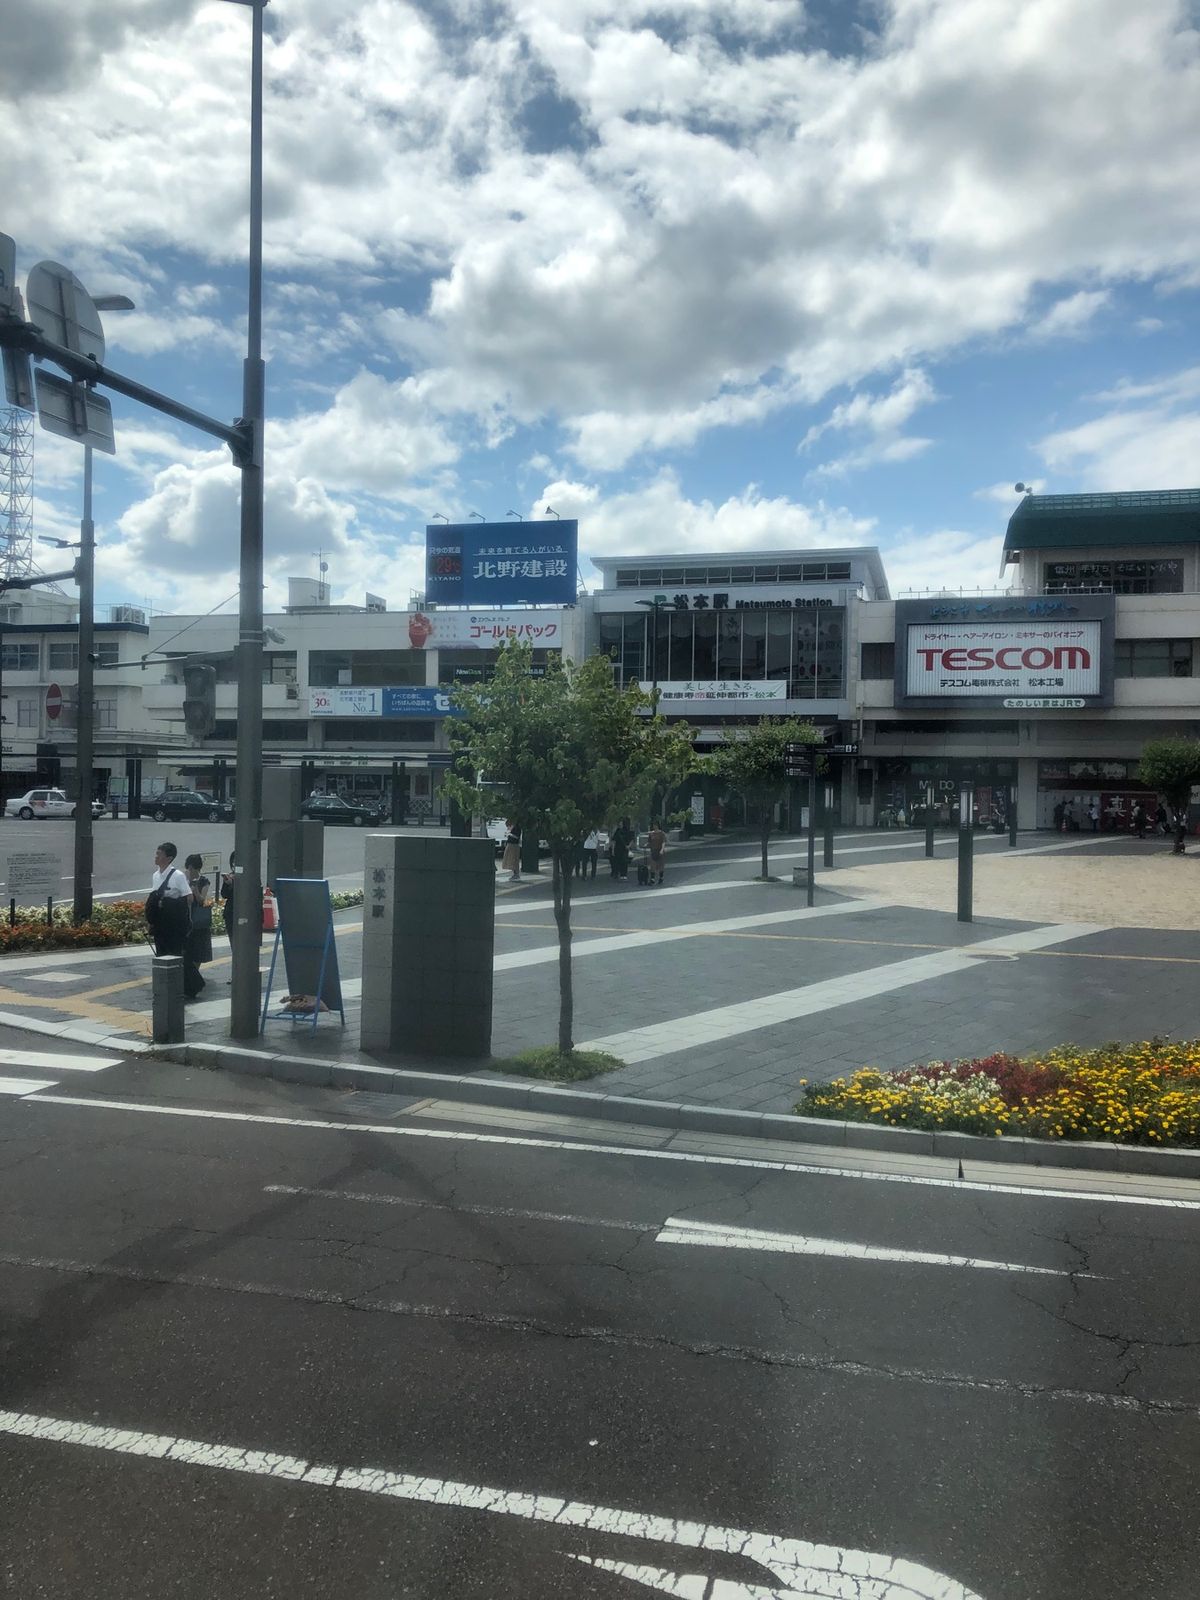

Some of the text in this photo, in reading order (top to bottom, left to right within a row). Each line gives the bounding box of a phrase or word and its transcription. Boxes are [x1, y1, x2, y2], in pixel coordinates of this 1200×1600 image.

[473, 559, 568, 579] 北野建設
[673, 593, 729, 610] 松本駅
[736, 600, 792, 609] Matsumoto
[795, 597, 833, 608] Station
[470, 624, 557, 638] ゴールドパック
[917, 647, 1091, 671] TESCOM
[940, 678, 1064, 687] テスコム電機株式会社 松本工場
[372, 868, 386, 918] 松本駅
